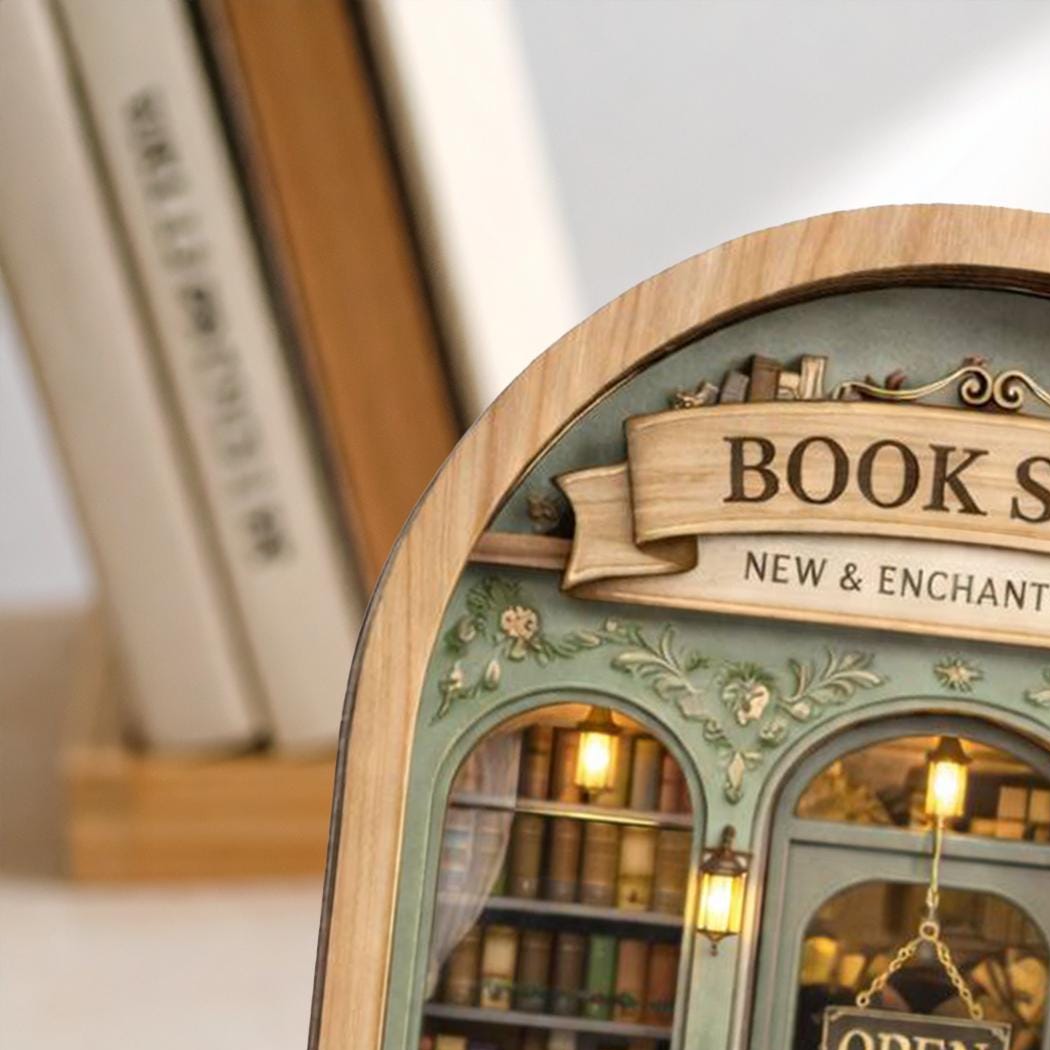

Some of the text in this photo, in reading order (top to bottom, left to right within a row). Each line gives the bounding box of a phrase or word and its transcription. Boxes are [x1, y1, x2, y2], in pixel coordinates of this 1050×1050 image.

[723, 435, 989, 516] BOOK
[744, 551, 827, 588] NEW
[840, 564, 863, 593] &
